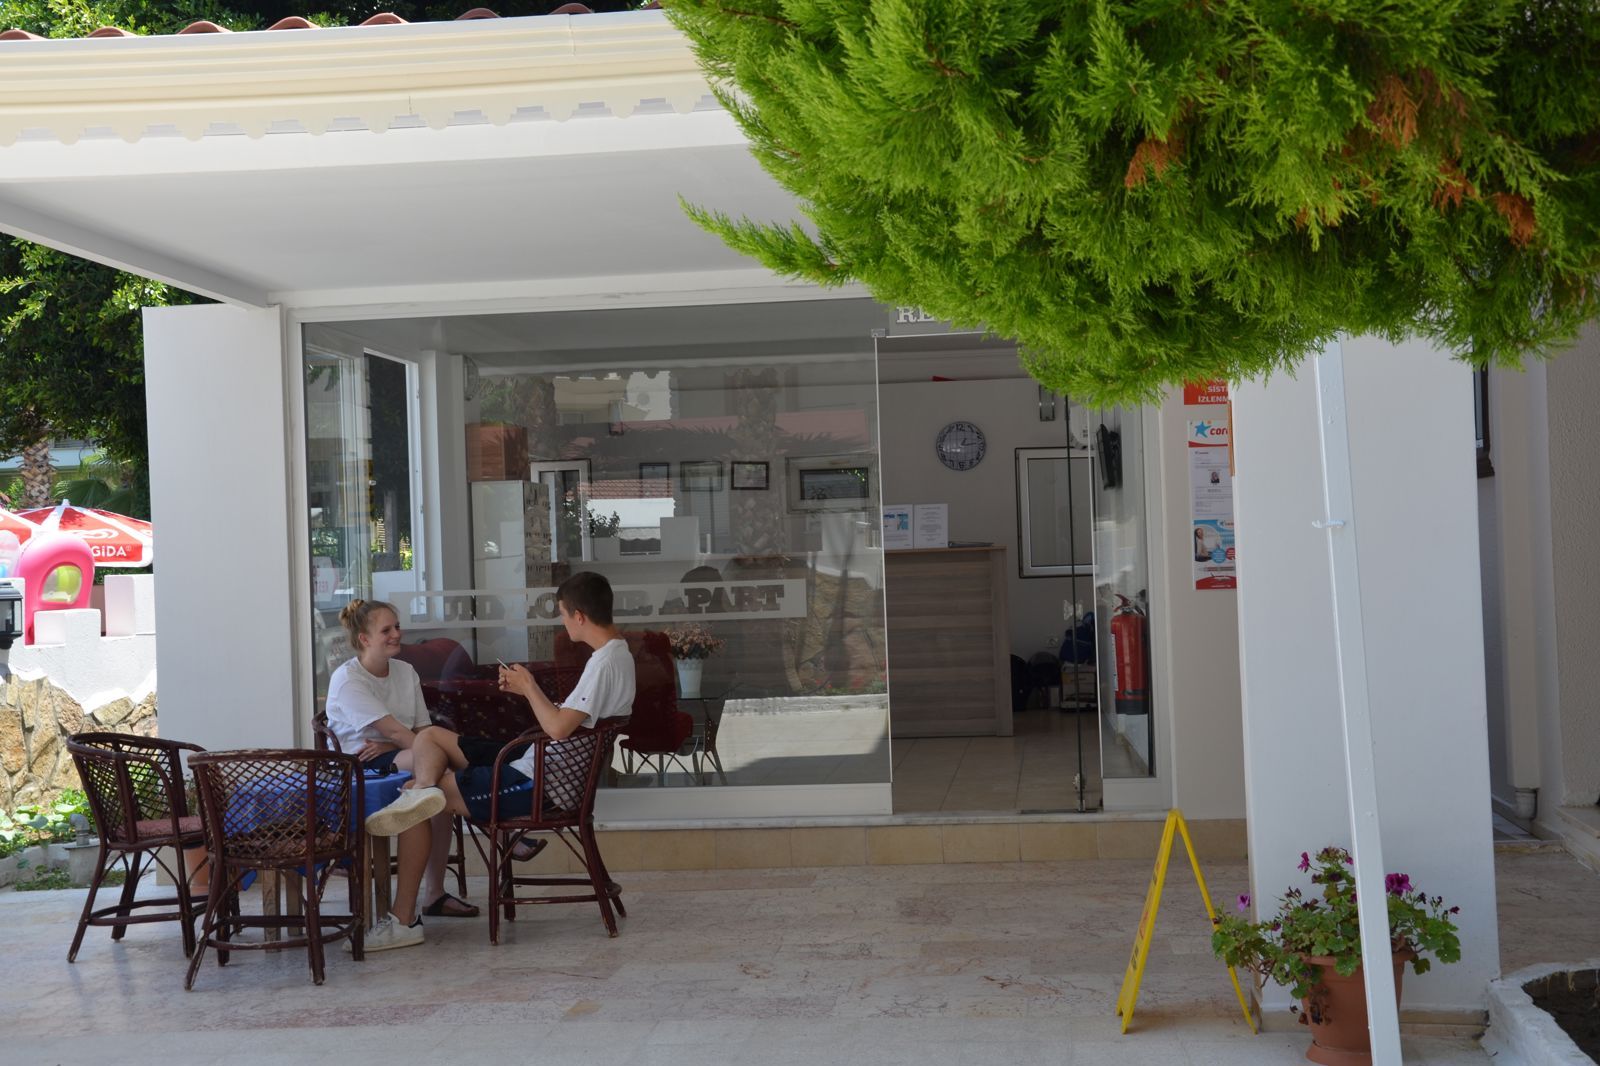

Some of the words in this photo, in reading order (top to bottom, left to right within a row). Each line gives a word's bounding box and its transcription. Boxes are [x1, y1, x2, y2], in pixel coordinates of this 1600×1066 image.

[896, 305, 951, 324] RE
[1209, 426, 1229, 437] cor
[656, 584, 785, 615] APART
